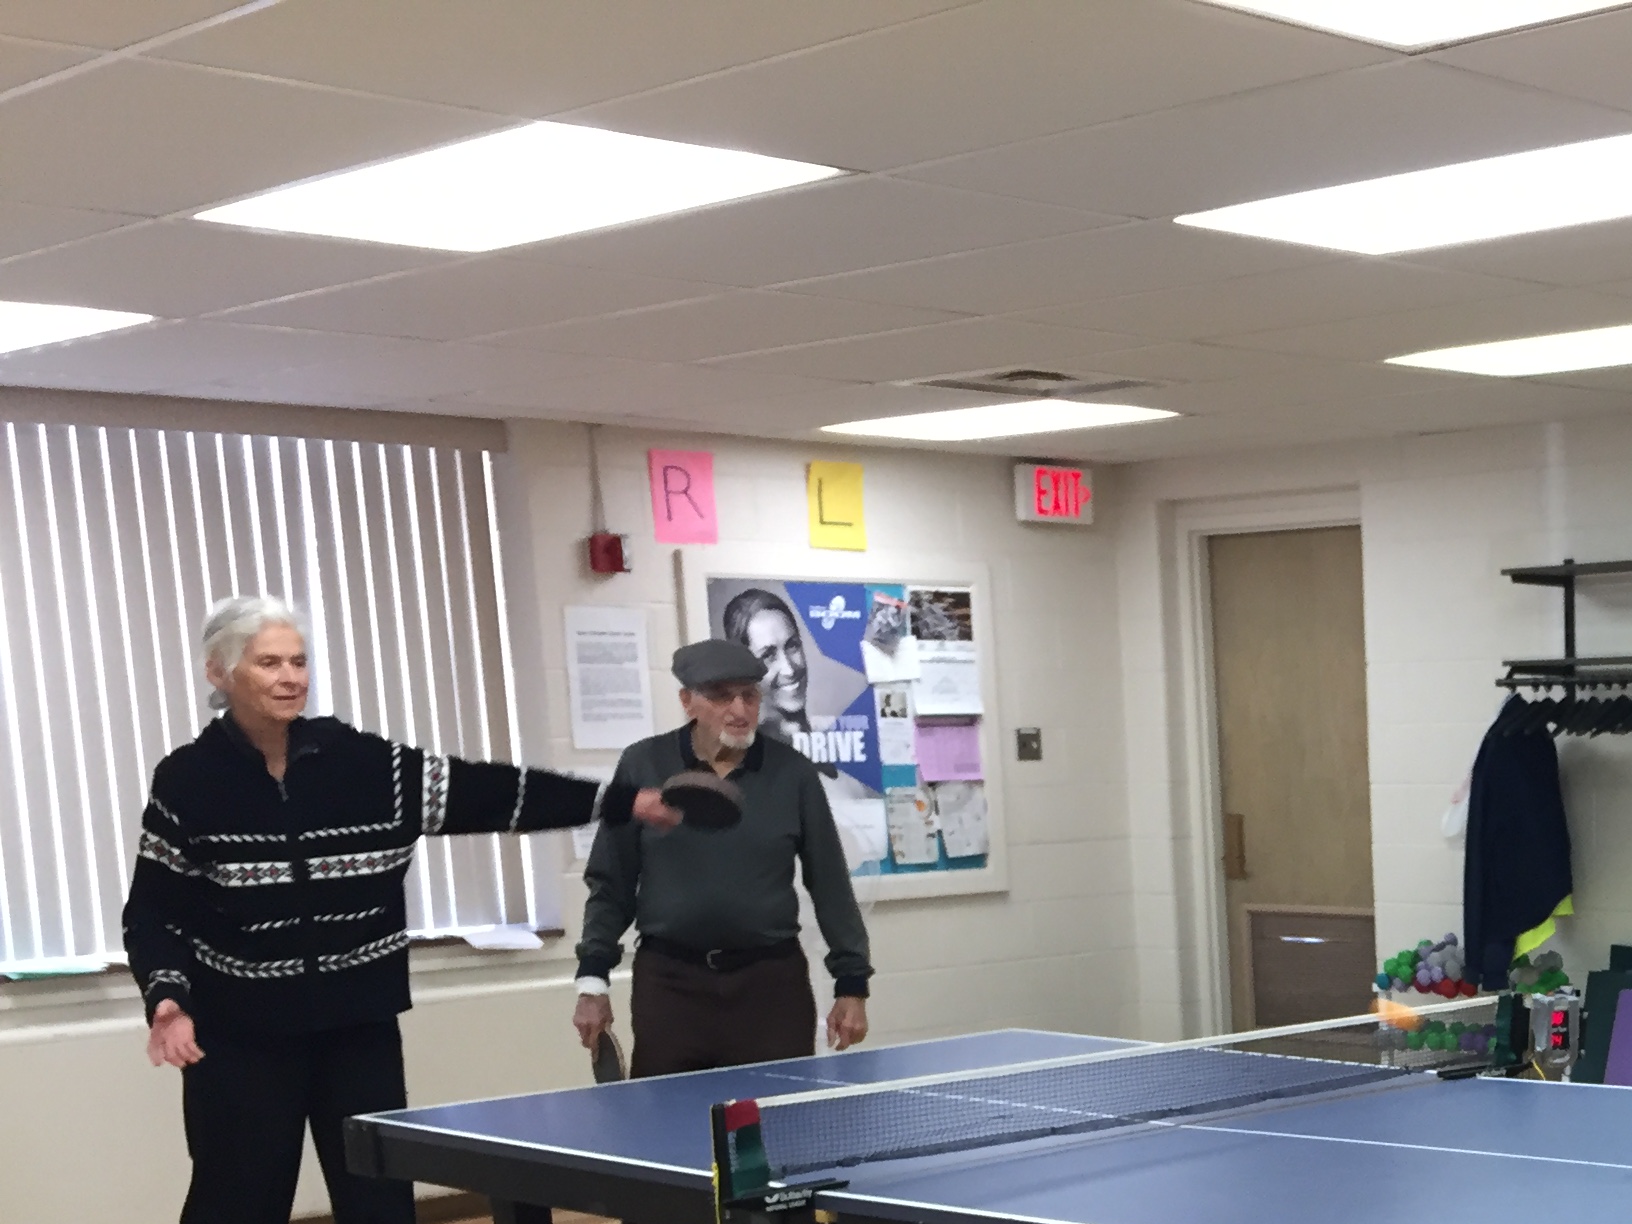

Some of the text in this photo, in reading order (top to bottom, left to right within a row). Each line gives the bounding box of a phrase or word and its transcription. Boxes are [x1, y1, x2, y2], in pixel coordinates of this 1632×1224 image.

[663, 465, 704, 522] R
[817, 477, 853, 526] L
[1035, 467, 1082, 519] EXIT
[792, 731, 867, 764] DRIVE
